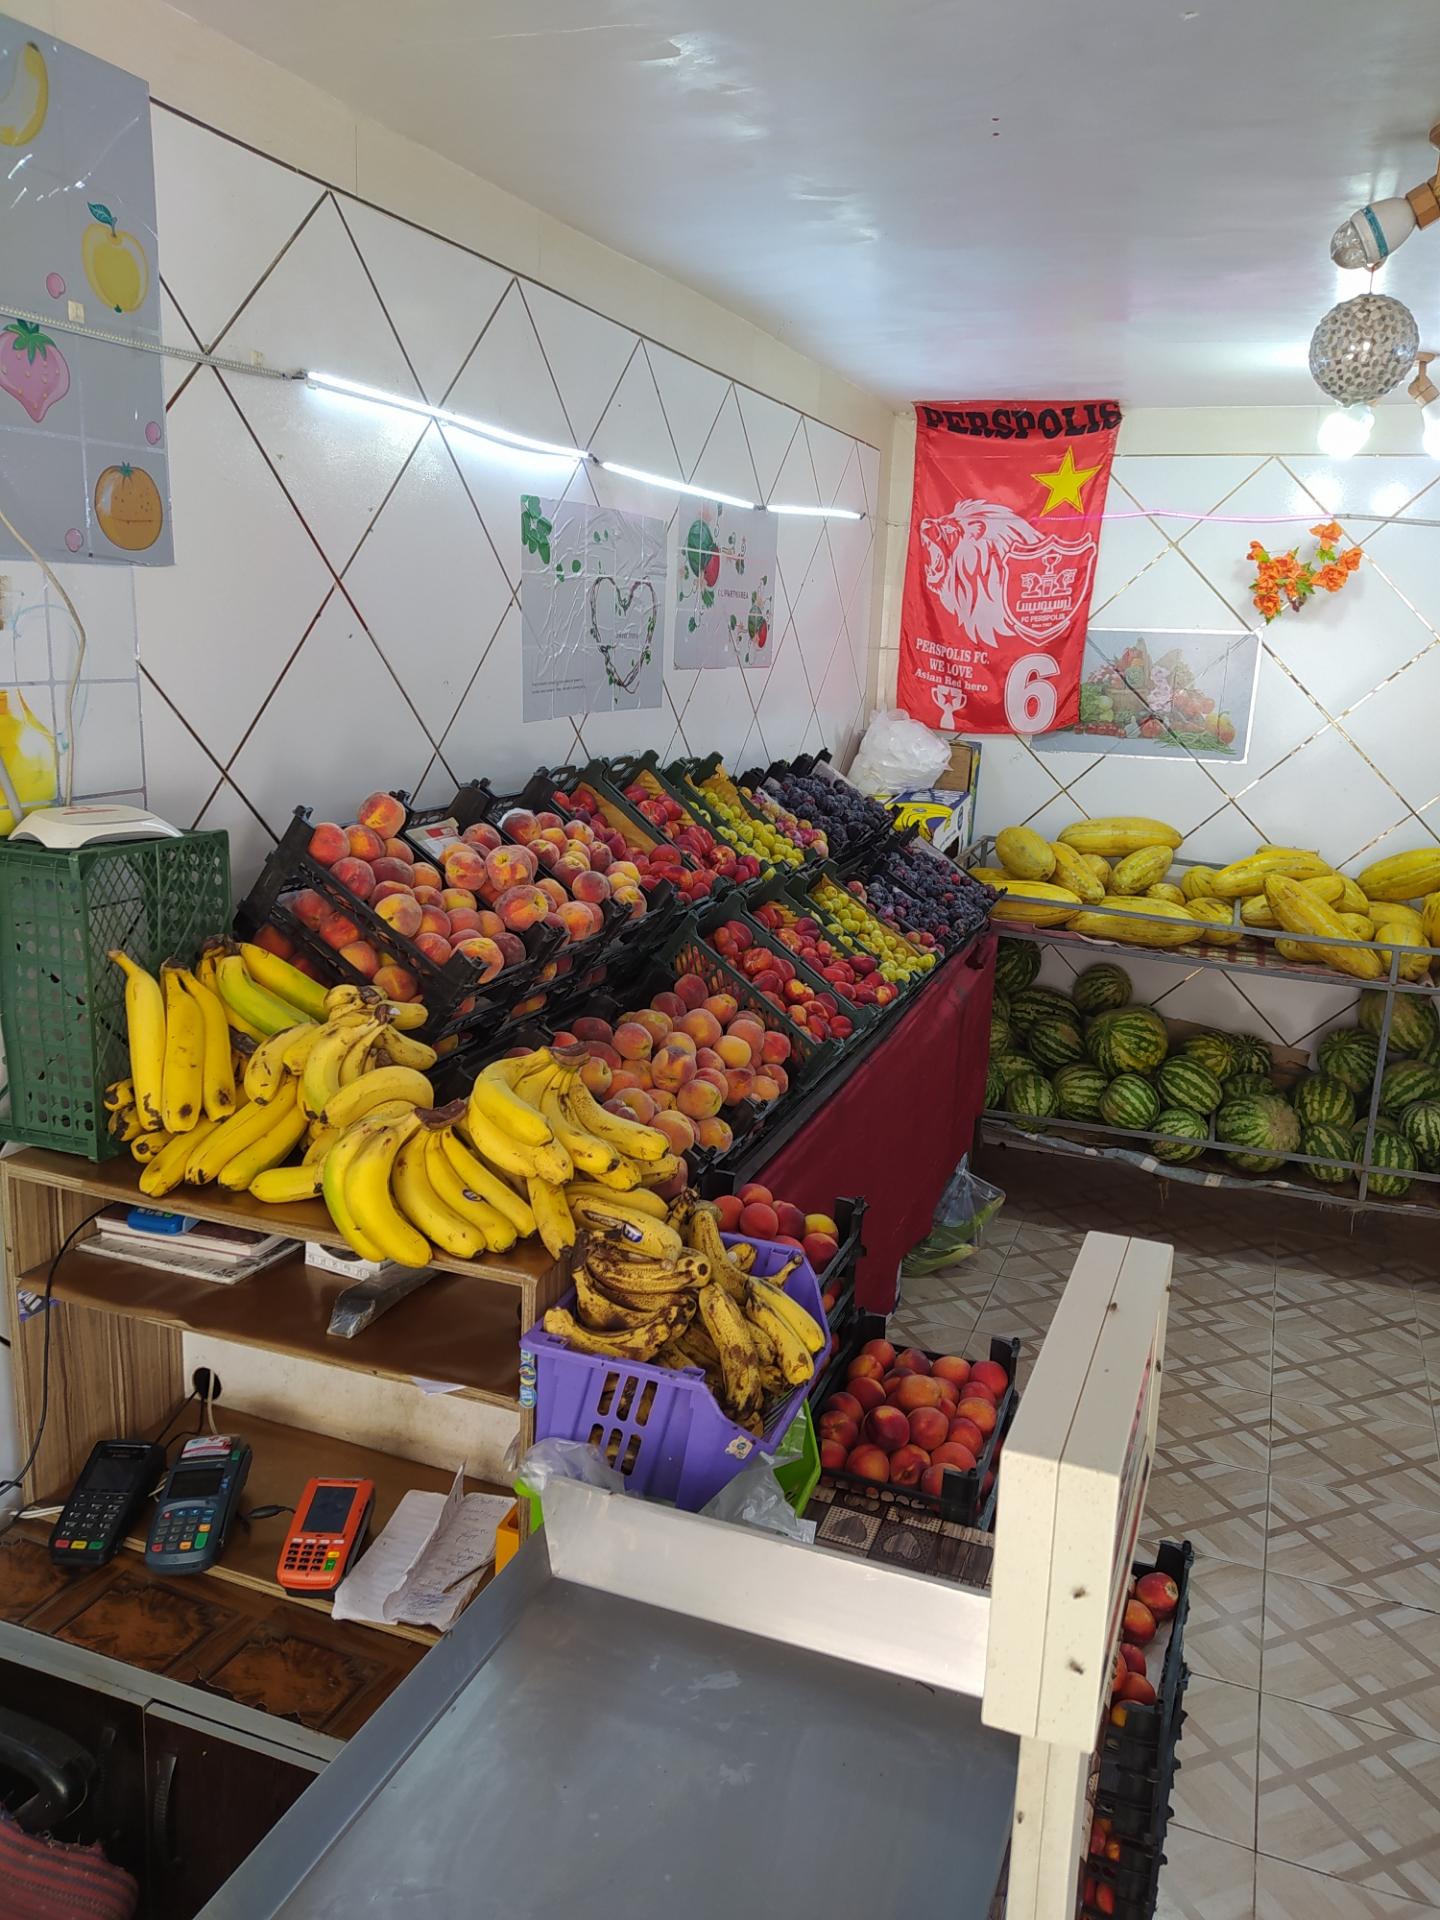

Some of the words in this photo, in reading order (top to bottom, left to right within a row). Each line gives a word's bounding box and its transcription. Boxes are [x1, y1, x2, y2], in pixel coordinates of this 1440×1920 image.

[924, 402, 1122, 439] PERSPOLIS
[915, 637, 972, 663] PERSPOLIS
[973, 651, 990, 665] FC.
[914, 668, 942, 684] Asian
[944, 677, 962, 688] Red
[964, 681, 989, 692] hero
[929, 658, 945, 673] WE
[946, 662, 973, 679] LOVE
[1004, 652, 1061, 735] 6
